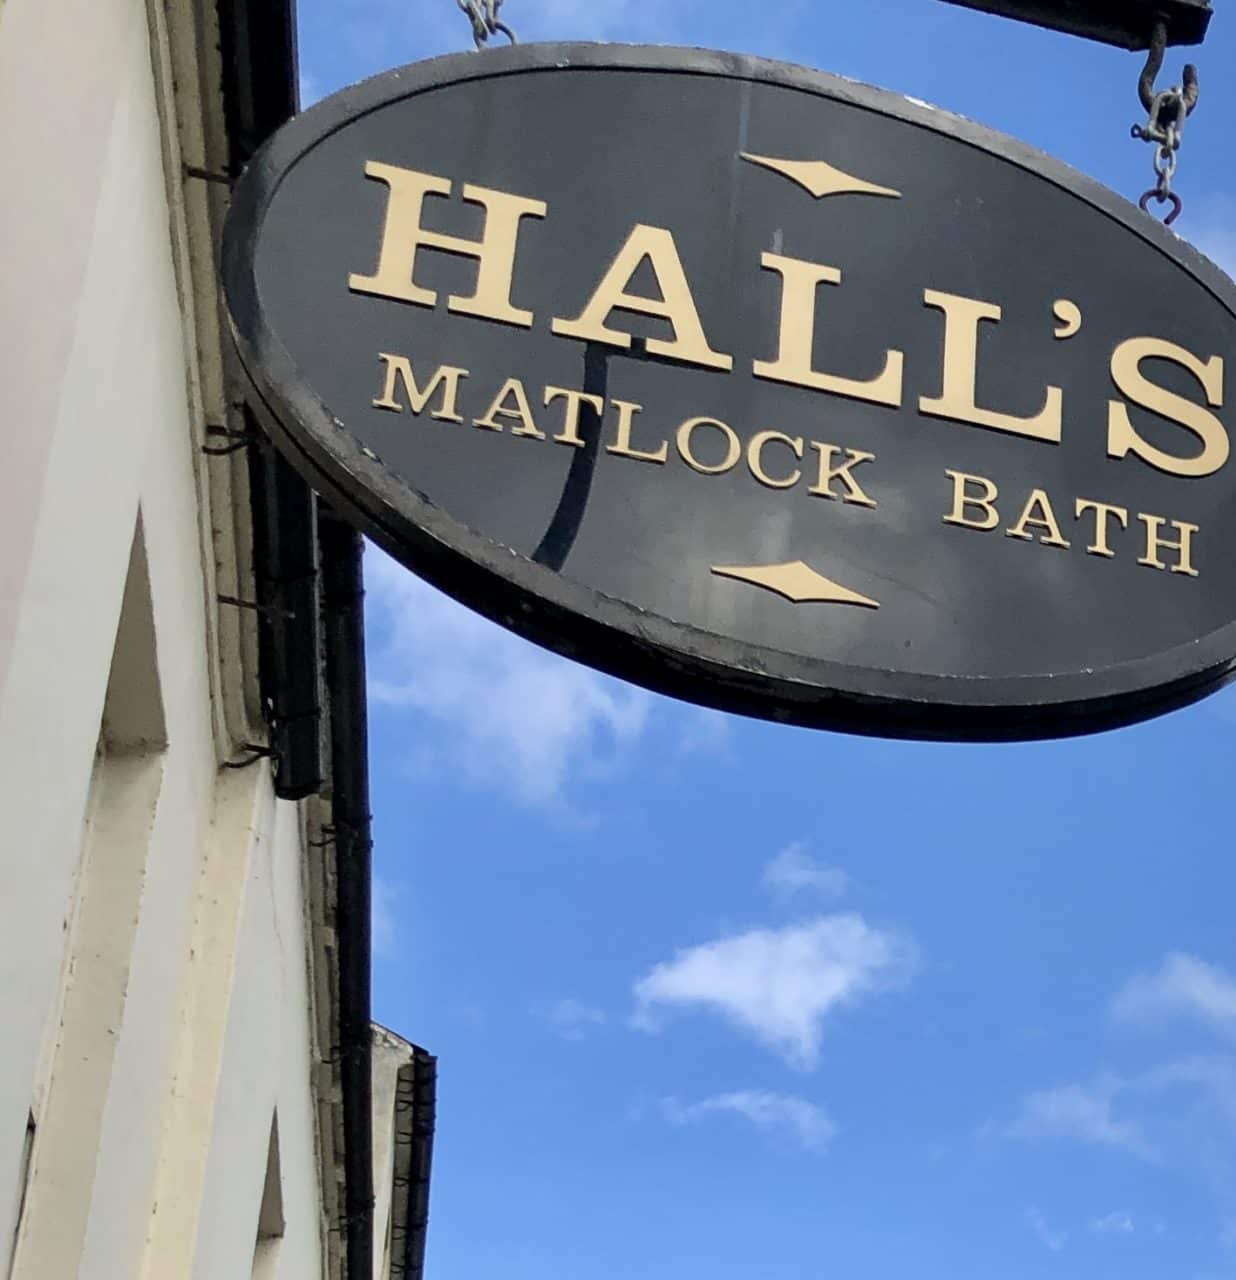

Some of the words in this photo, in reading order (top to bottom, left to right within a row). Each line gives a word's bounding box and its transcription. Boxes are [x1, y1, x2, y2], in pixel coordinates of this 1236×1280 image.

[348, 160, 1230, 477] HALL'S
[372, 352, 877, 508] MATLOCK
[942, 469, 1199, 577] BATH
